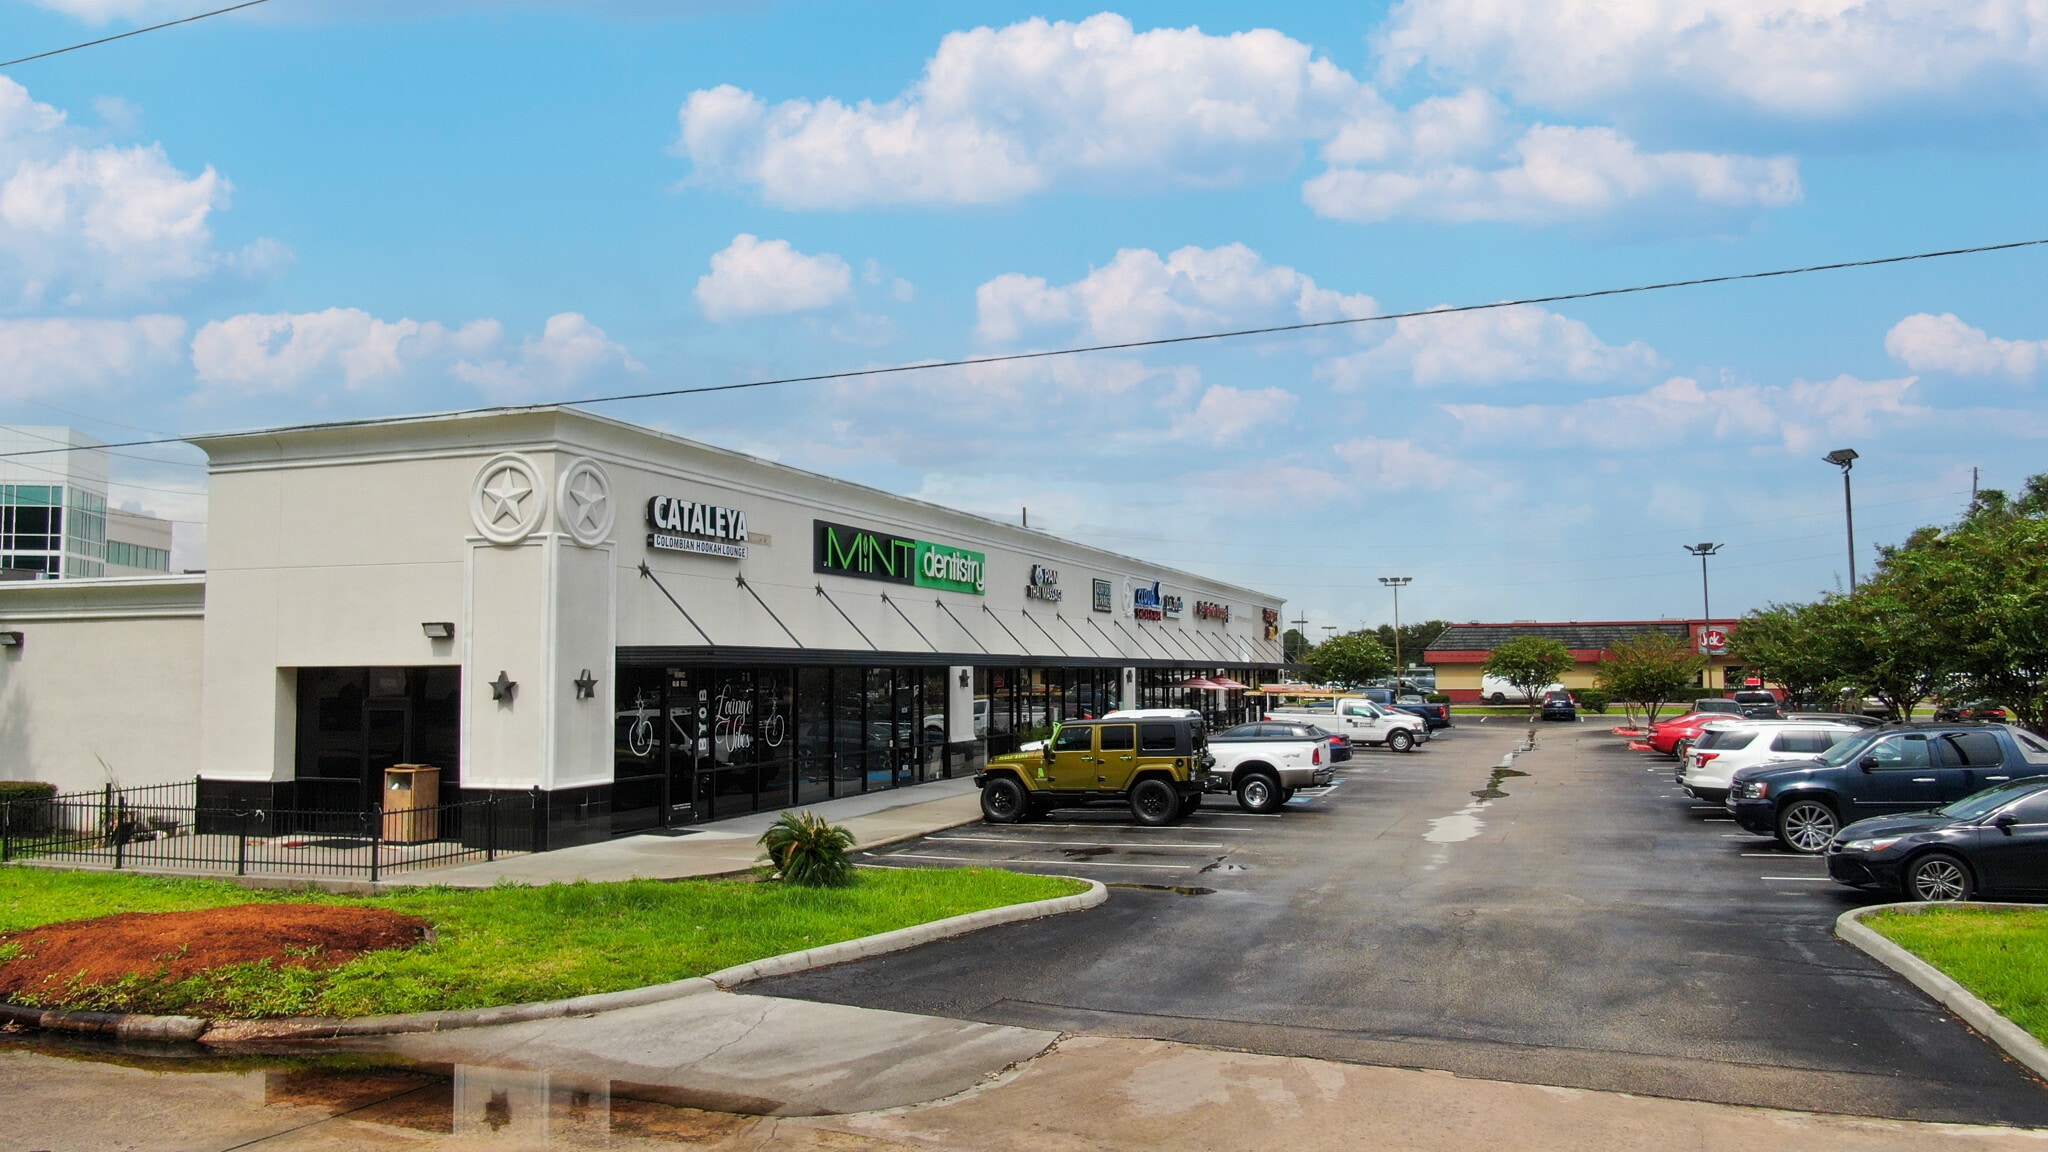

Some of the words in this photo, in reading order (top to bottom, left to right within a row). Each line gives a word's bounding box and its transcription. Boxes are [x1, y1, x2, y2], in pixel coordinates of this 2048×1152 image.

[653, 494, 749, 541] CATALEYA
[656, 535, 695, 551] COLOMBIAN
[696, 541, 722, 554] HOOKAH
[722, 546, 746, 558] LOUNGE
[923, 545, 985, 592] dentistry
[1701, 631, 1725, 647] Jck
[715, 684, 752, 726] Lounge
[714, 715, 750, 753] Vibes
